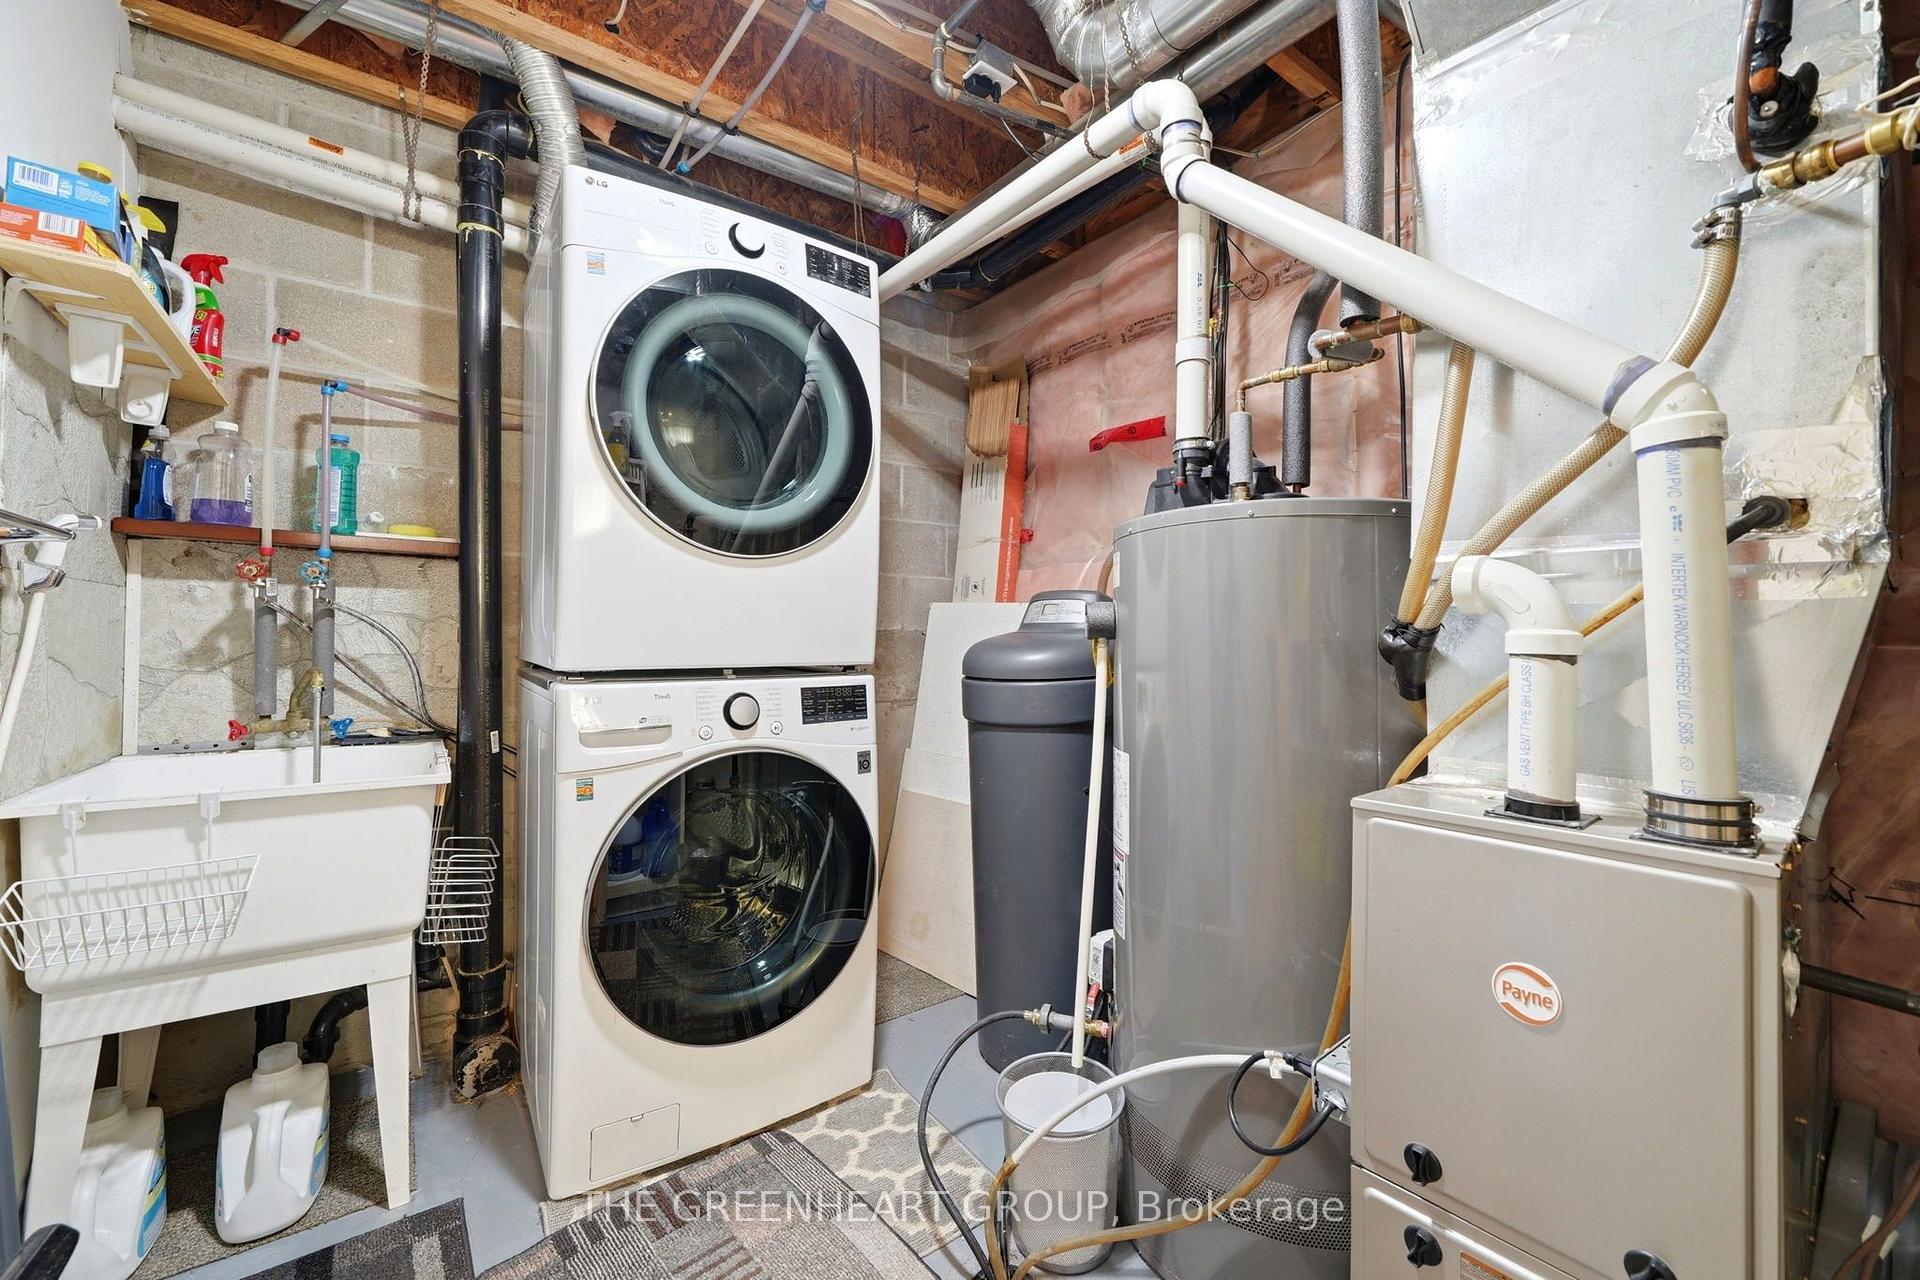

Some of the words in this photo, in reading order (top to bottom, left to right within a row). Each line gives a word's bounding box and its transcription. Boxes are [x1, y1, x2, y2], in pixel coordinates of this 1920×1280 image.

[596, 179, 609, 188] LG
[1670, 553, 1688, 602] INTERTEK
[1672, 602, 1691, 657] WARNOCK
[1520, 663, 1533, 694] CLASS
[1674, 656, 1692, 700] HERSEY
[1520, 694, 1532, 708] BH
[1677, 701, 1694, 720] ULC
[1520, 709, 1532, 731] TYPE
[1519, 733, 1532, 756] VENT
[1519, 758, 1531, 777] GAS
[1503, 980, 1554, 1010] Payne
